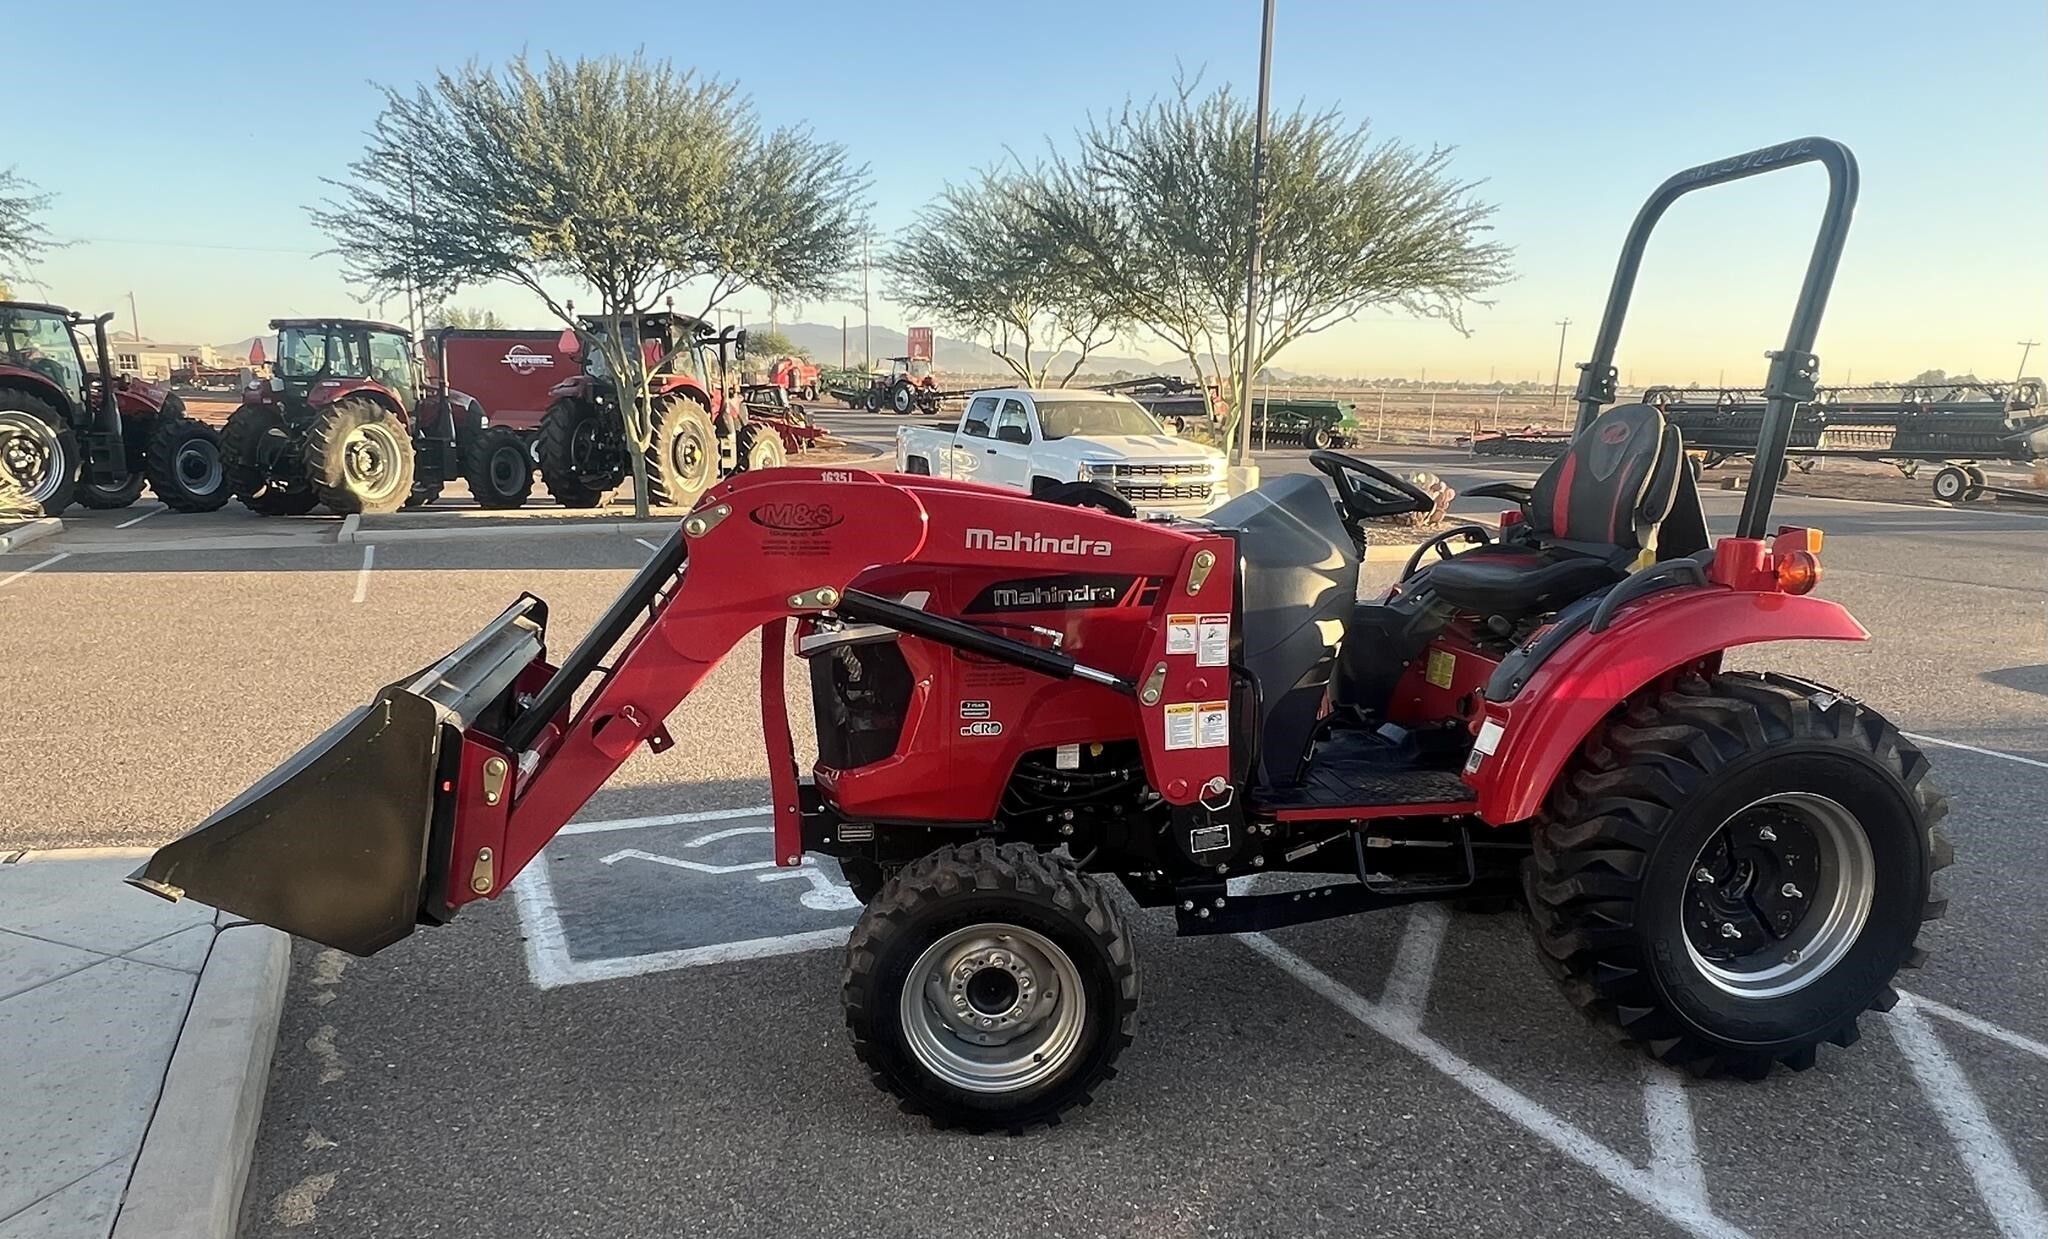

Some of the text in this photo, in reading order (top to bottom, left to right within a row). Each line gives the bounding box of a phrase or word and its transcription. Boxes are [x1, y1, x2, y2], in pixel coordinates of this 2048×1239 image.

[763, 503, 833, 526] M&S
[965, 528, 1112, 556] Mahindra
[993, 584, 1116, 606] Mahindra
